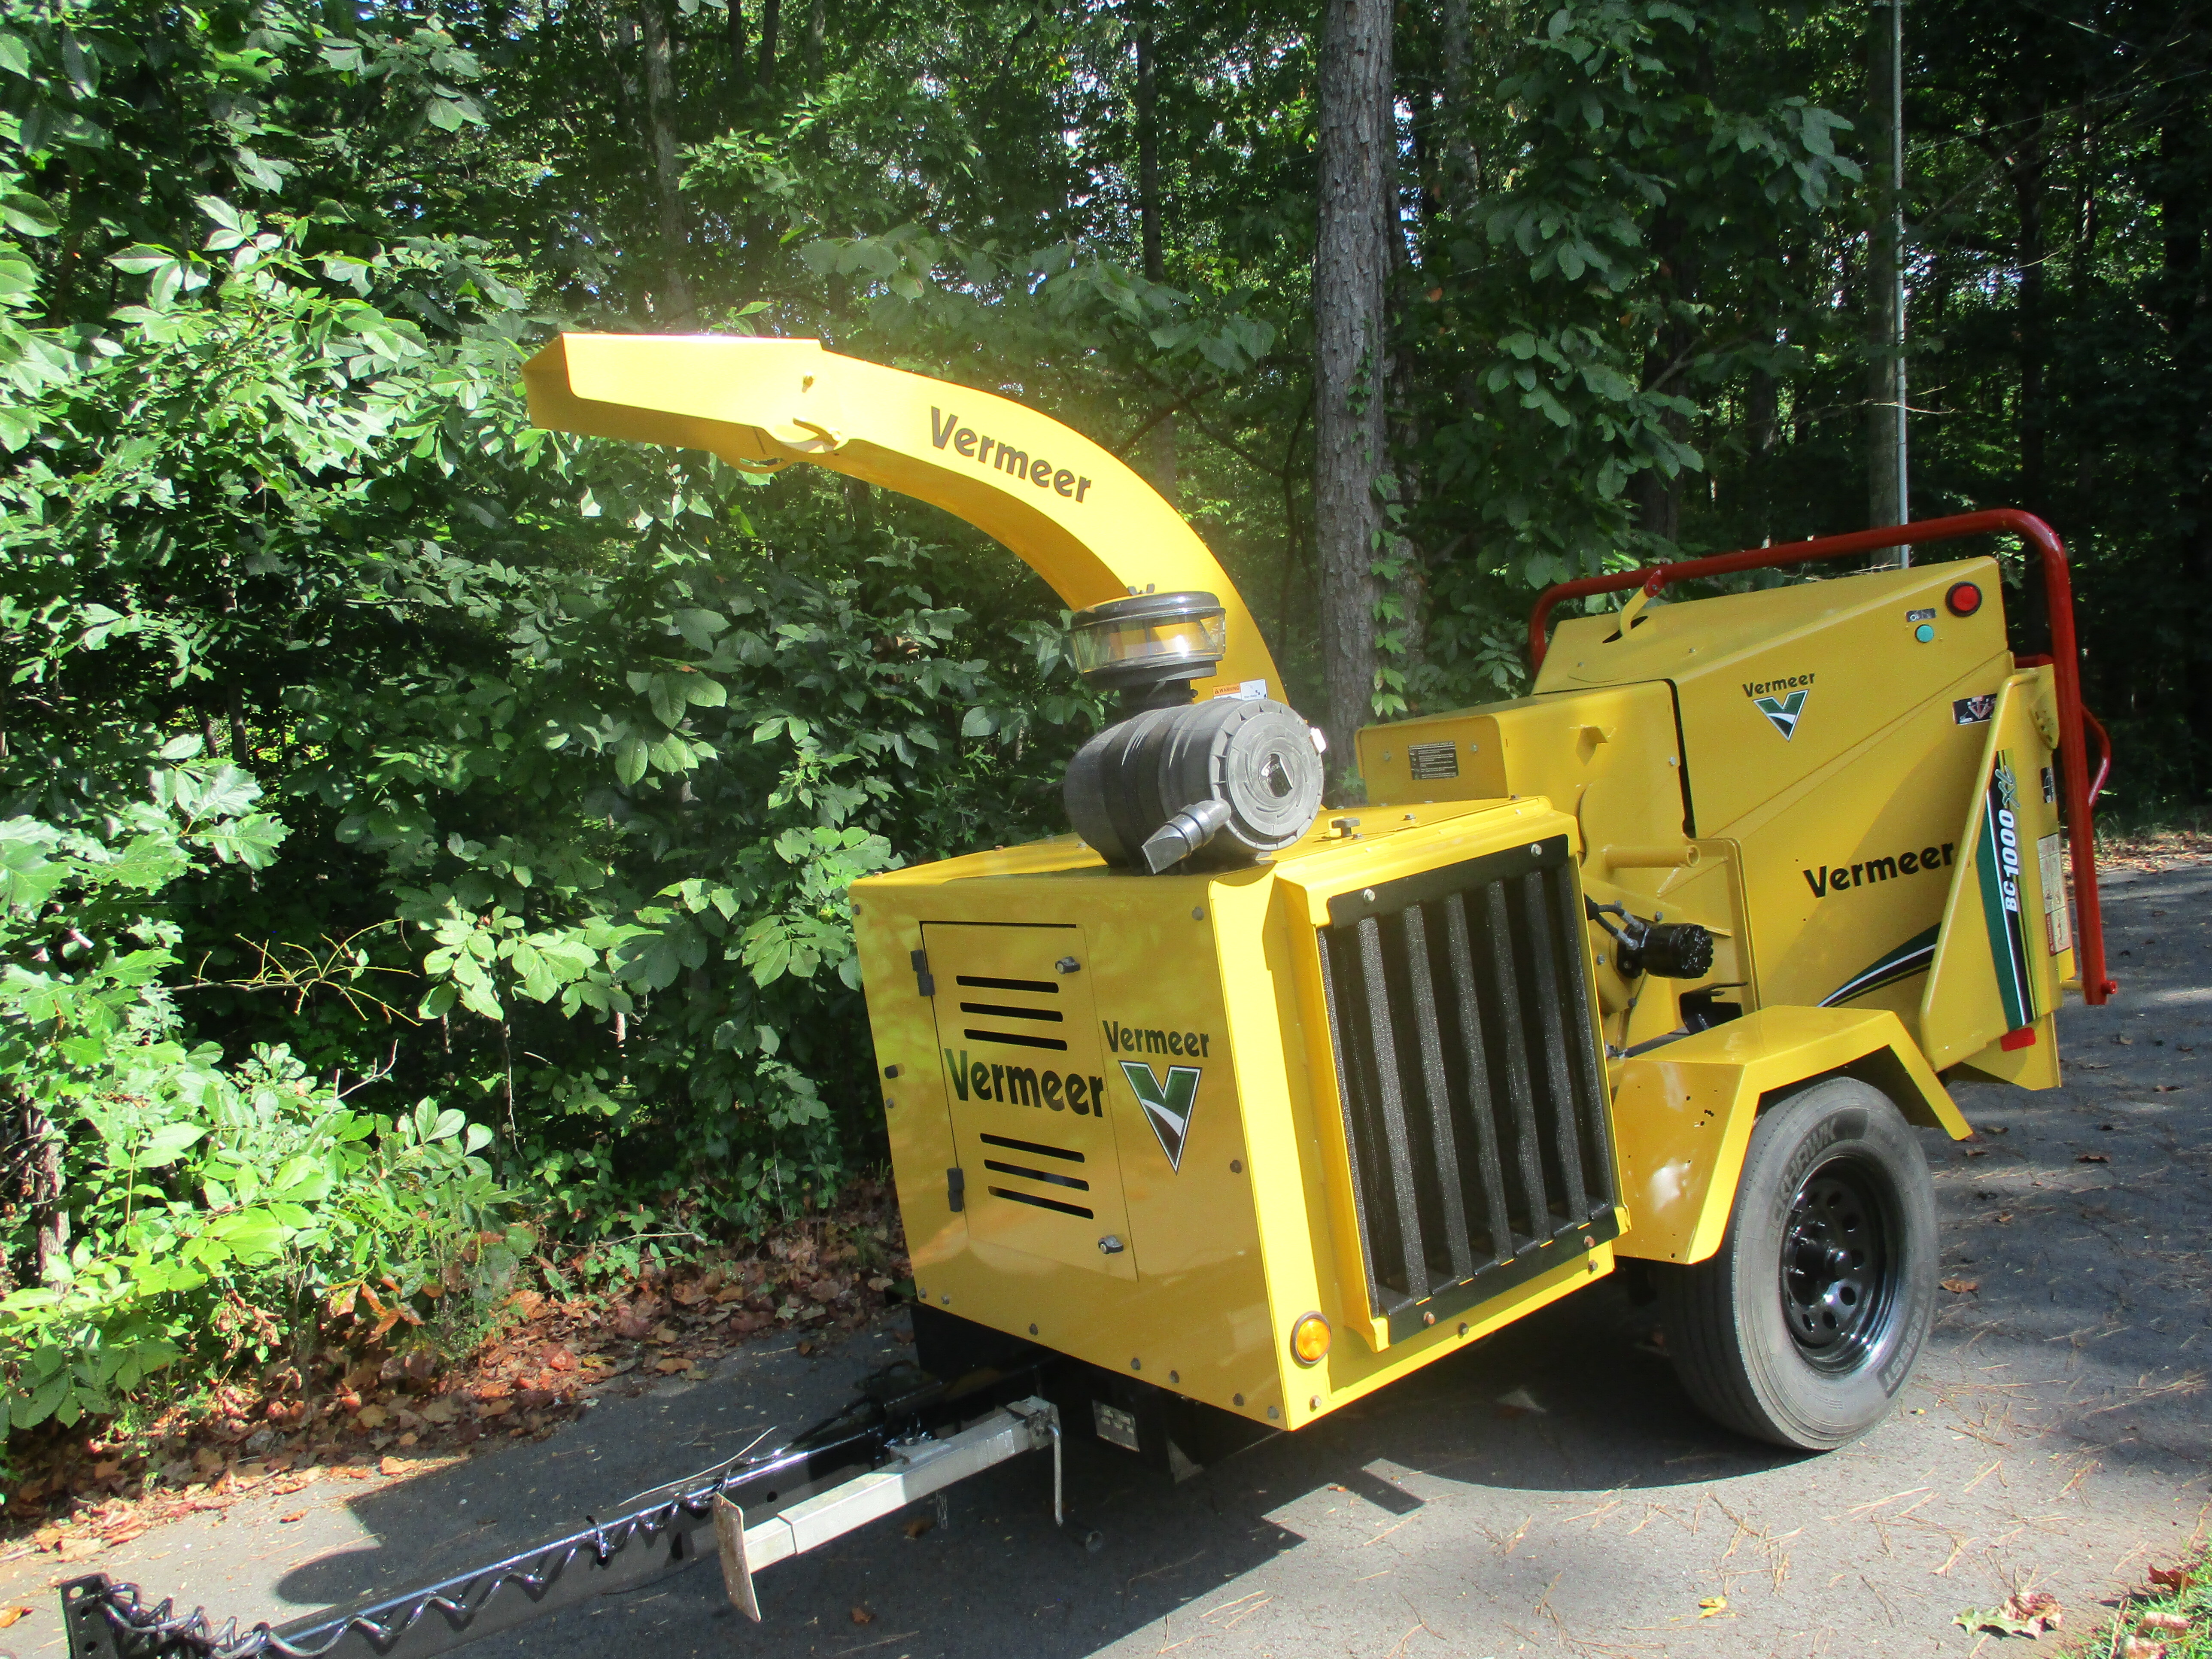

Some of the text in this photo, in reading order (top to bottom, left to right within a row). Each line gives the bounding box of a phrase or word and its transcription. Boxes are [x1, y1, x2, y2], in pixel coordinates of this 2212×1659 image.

[931, 405, 1092, 503] Vermeer
[1742, 672, 1815, 697] Vermeer
[1802, 842, 1954, 899] Vermeer
[1102, 1020, 1210, 1058] Vermeer
[944, 1048, 1104, 1118] Vermeer
